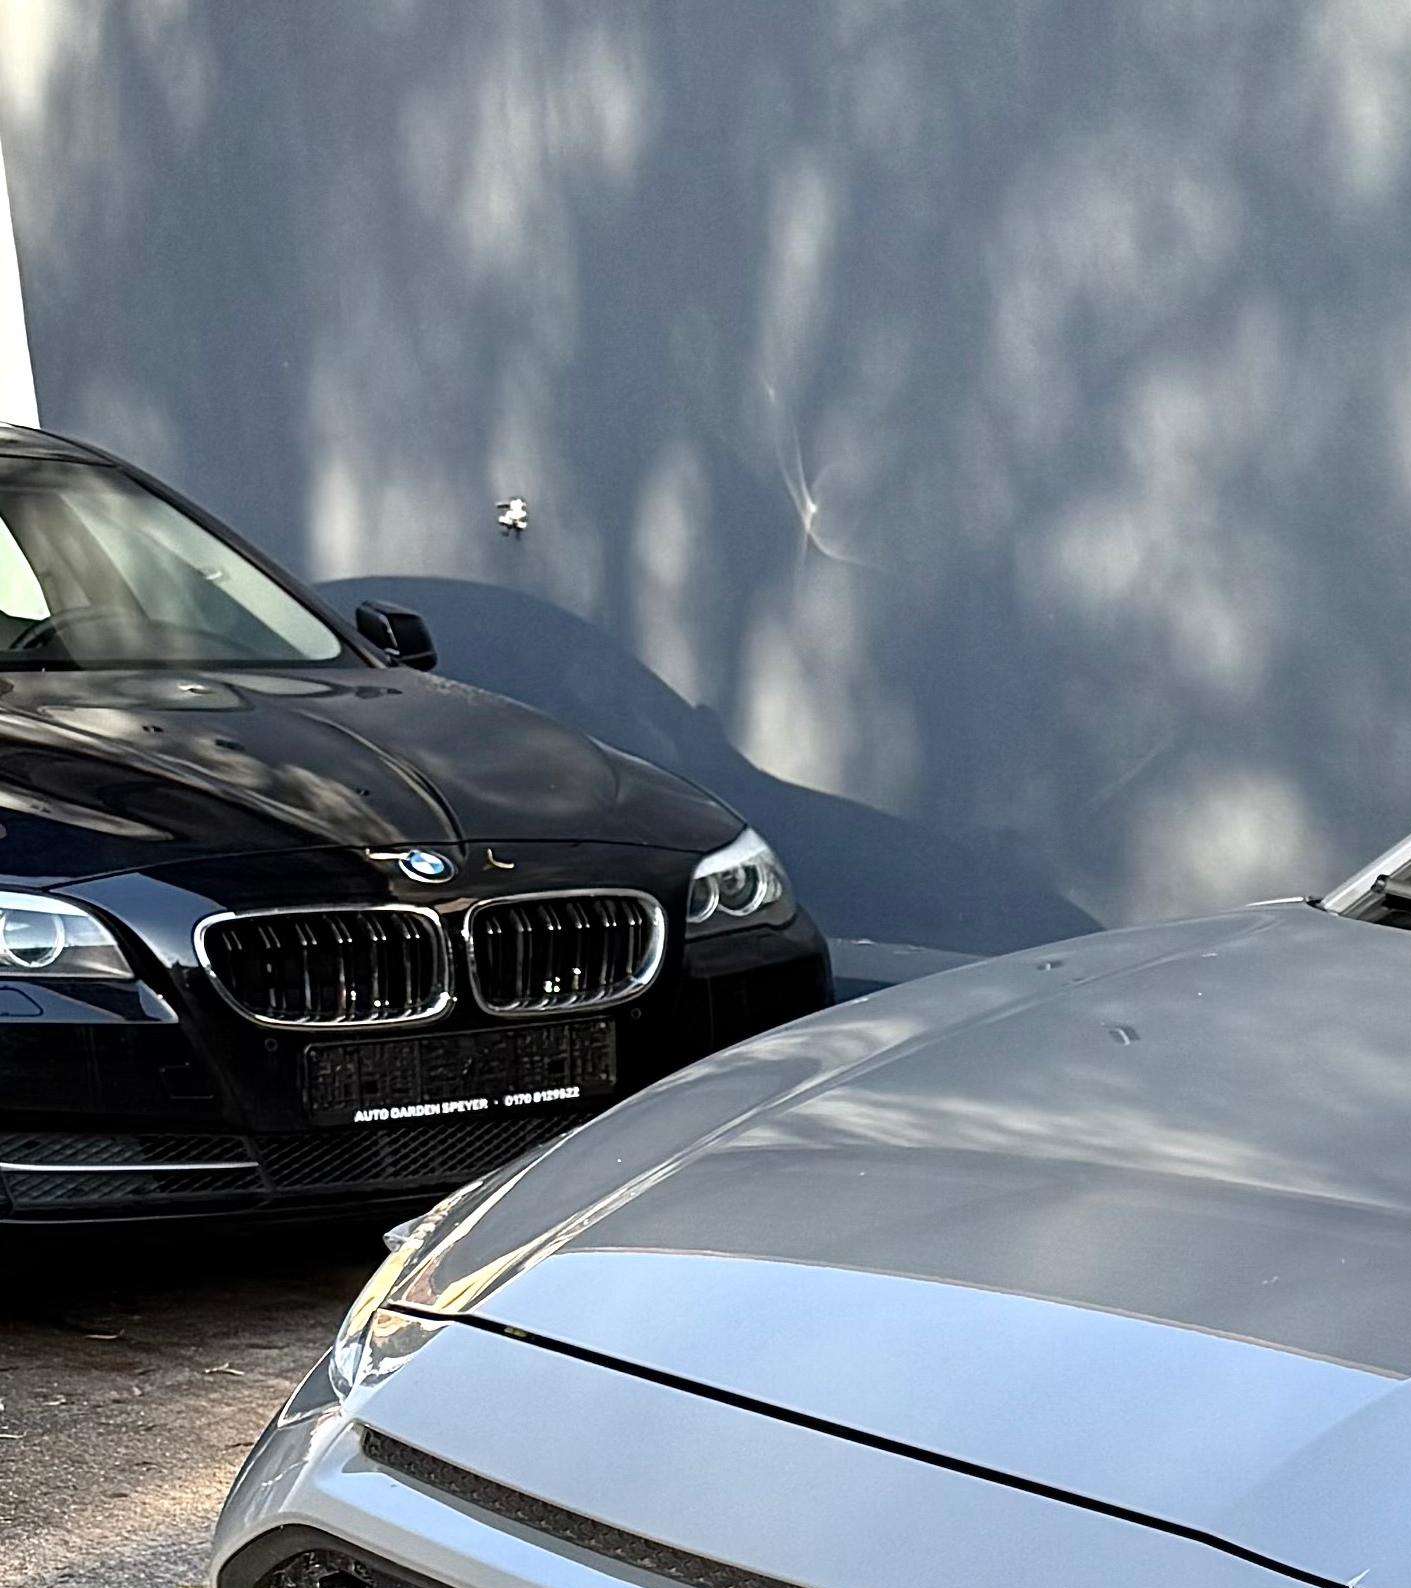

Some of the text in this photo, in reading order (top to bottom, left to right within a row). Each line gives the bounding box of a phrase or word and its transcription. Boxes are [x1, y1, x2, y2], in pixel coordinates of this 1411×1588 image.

[353, 1108, 390, 1123] AUTO
[390, 1103, 441, 1119] GARDEN
[441, 1097, 489, 1114] SPEYER
